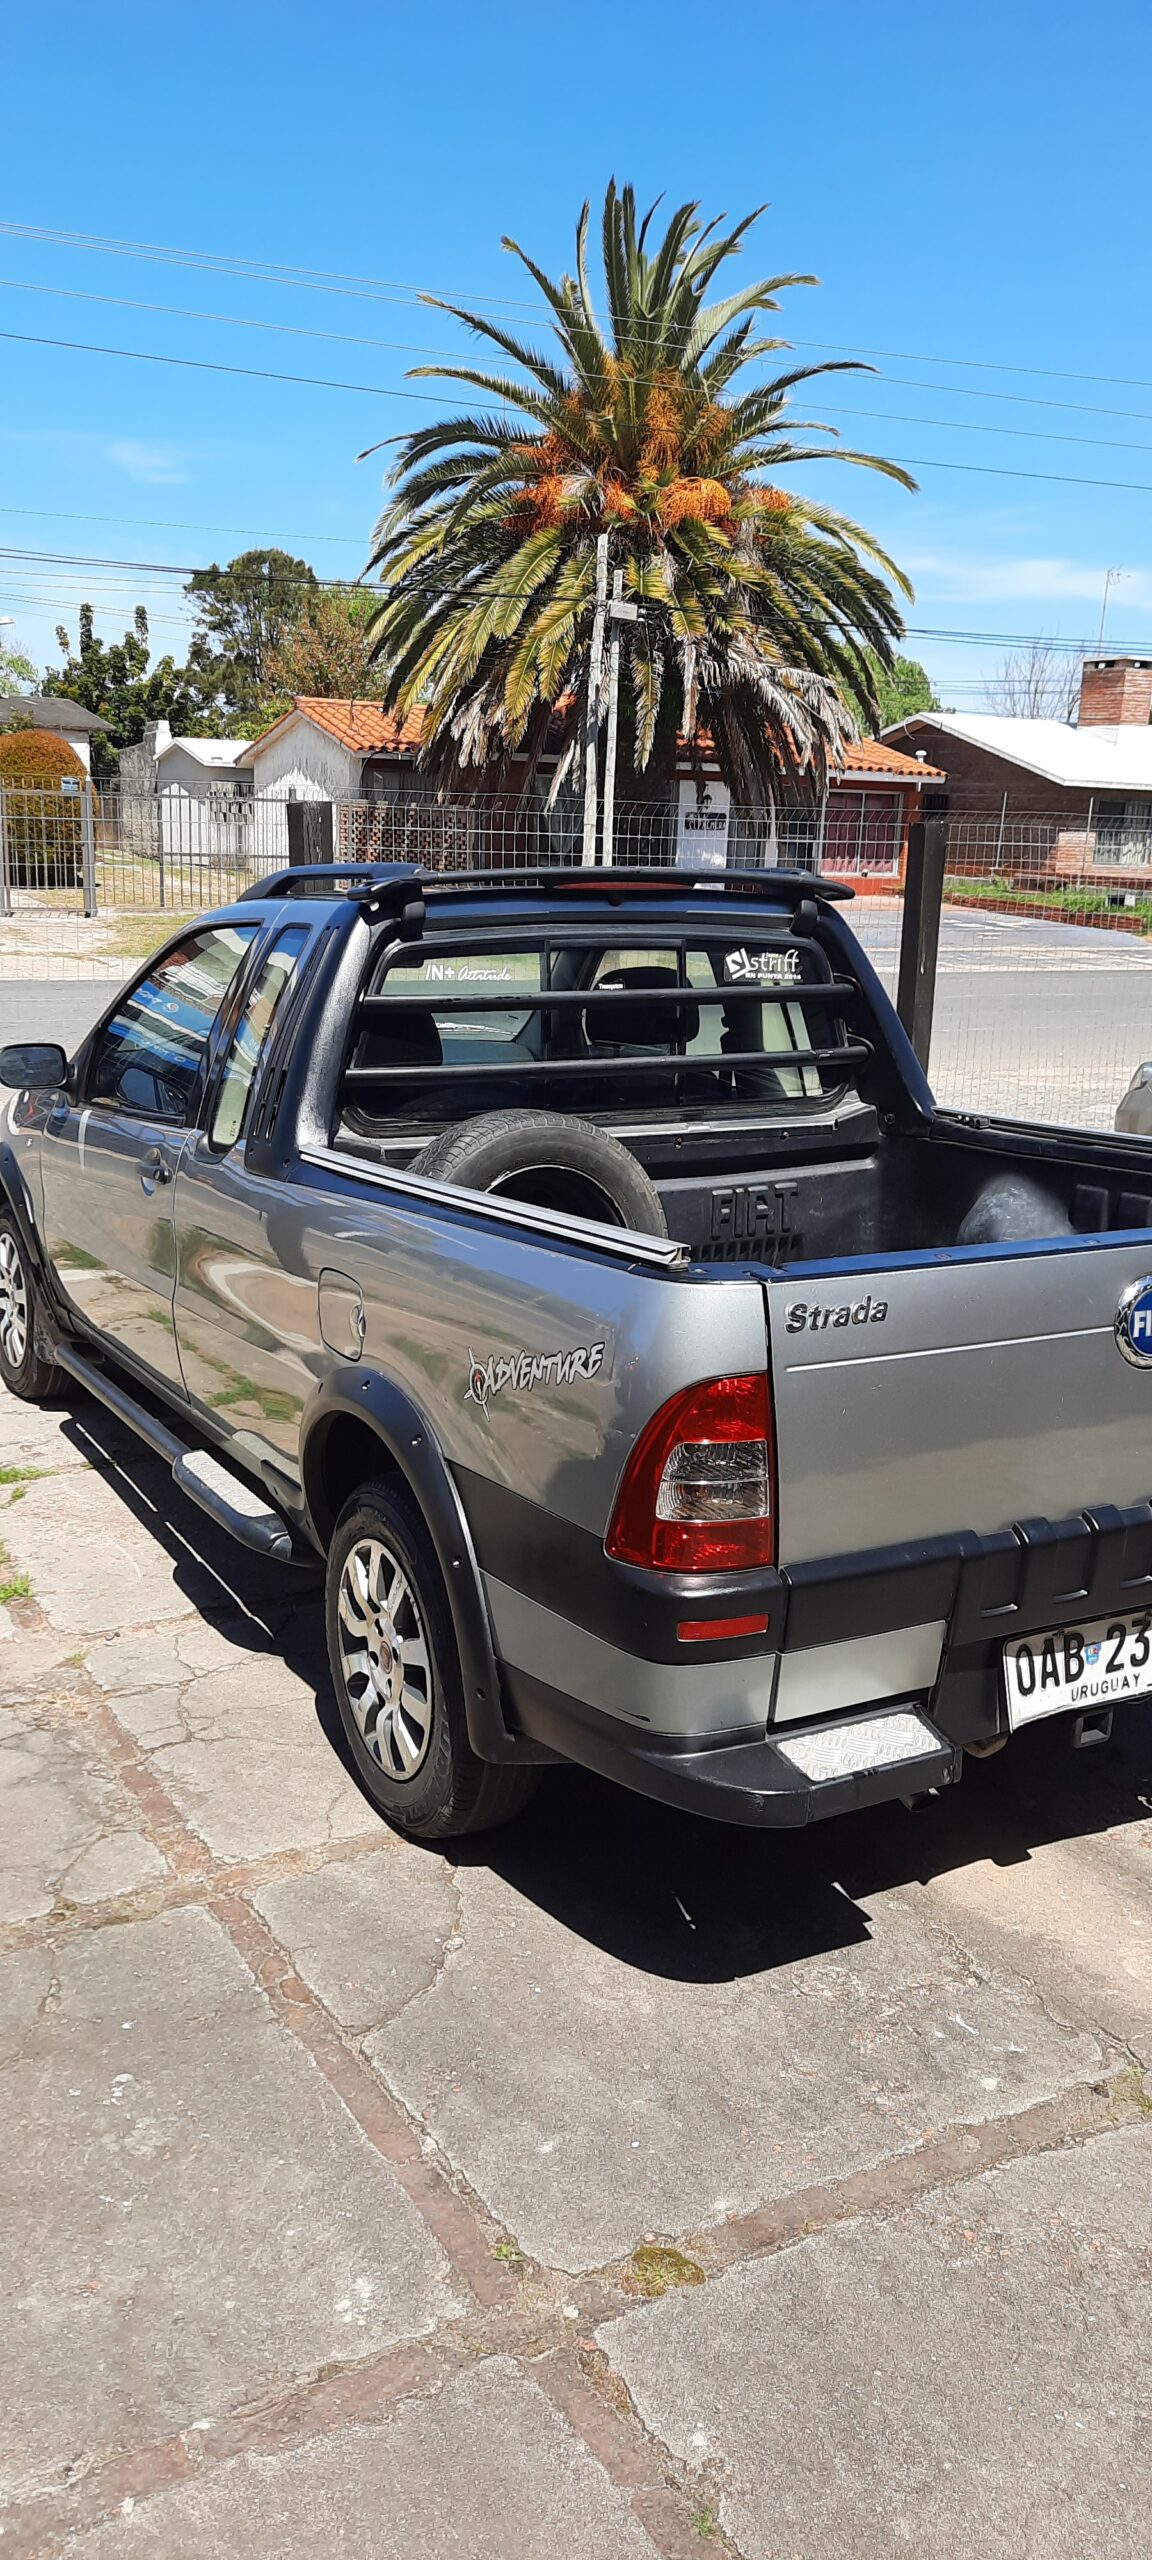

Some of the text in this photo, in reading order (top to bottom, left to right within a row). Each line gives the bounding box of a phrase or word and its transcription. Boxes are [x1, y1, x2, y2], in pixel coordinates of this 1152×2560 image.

[711, 1182, 799, 1241] FIAT
[785, 1295, 889, 1333] Strada
[481, 1341, 606, 1397] ADVENTURE
[1015, 1632, 1085, 1697] OAB
[1071, 1673, 1141, 1703] URUGUAY
